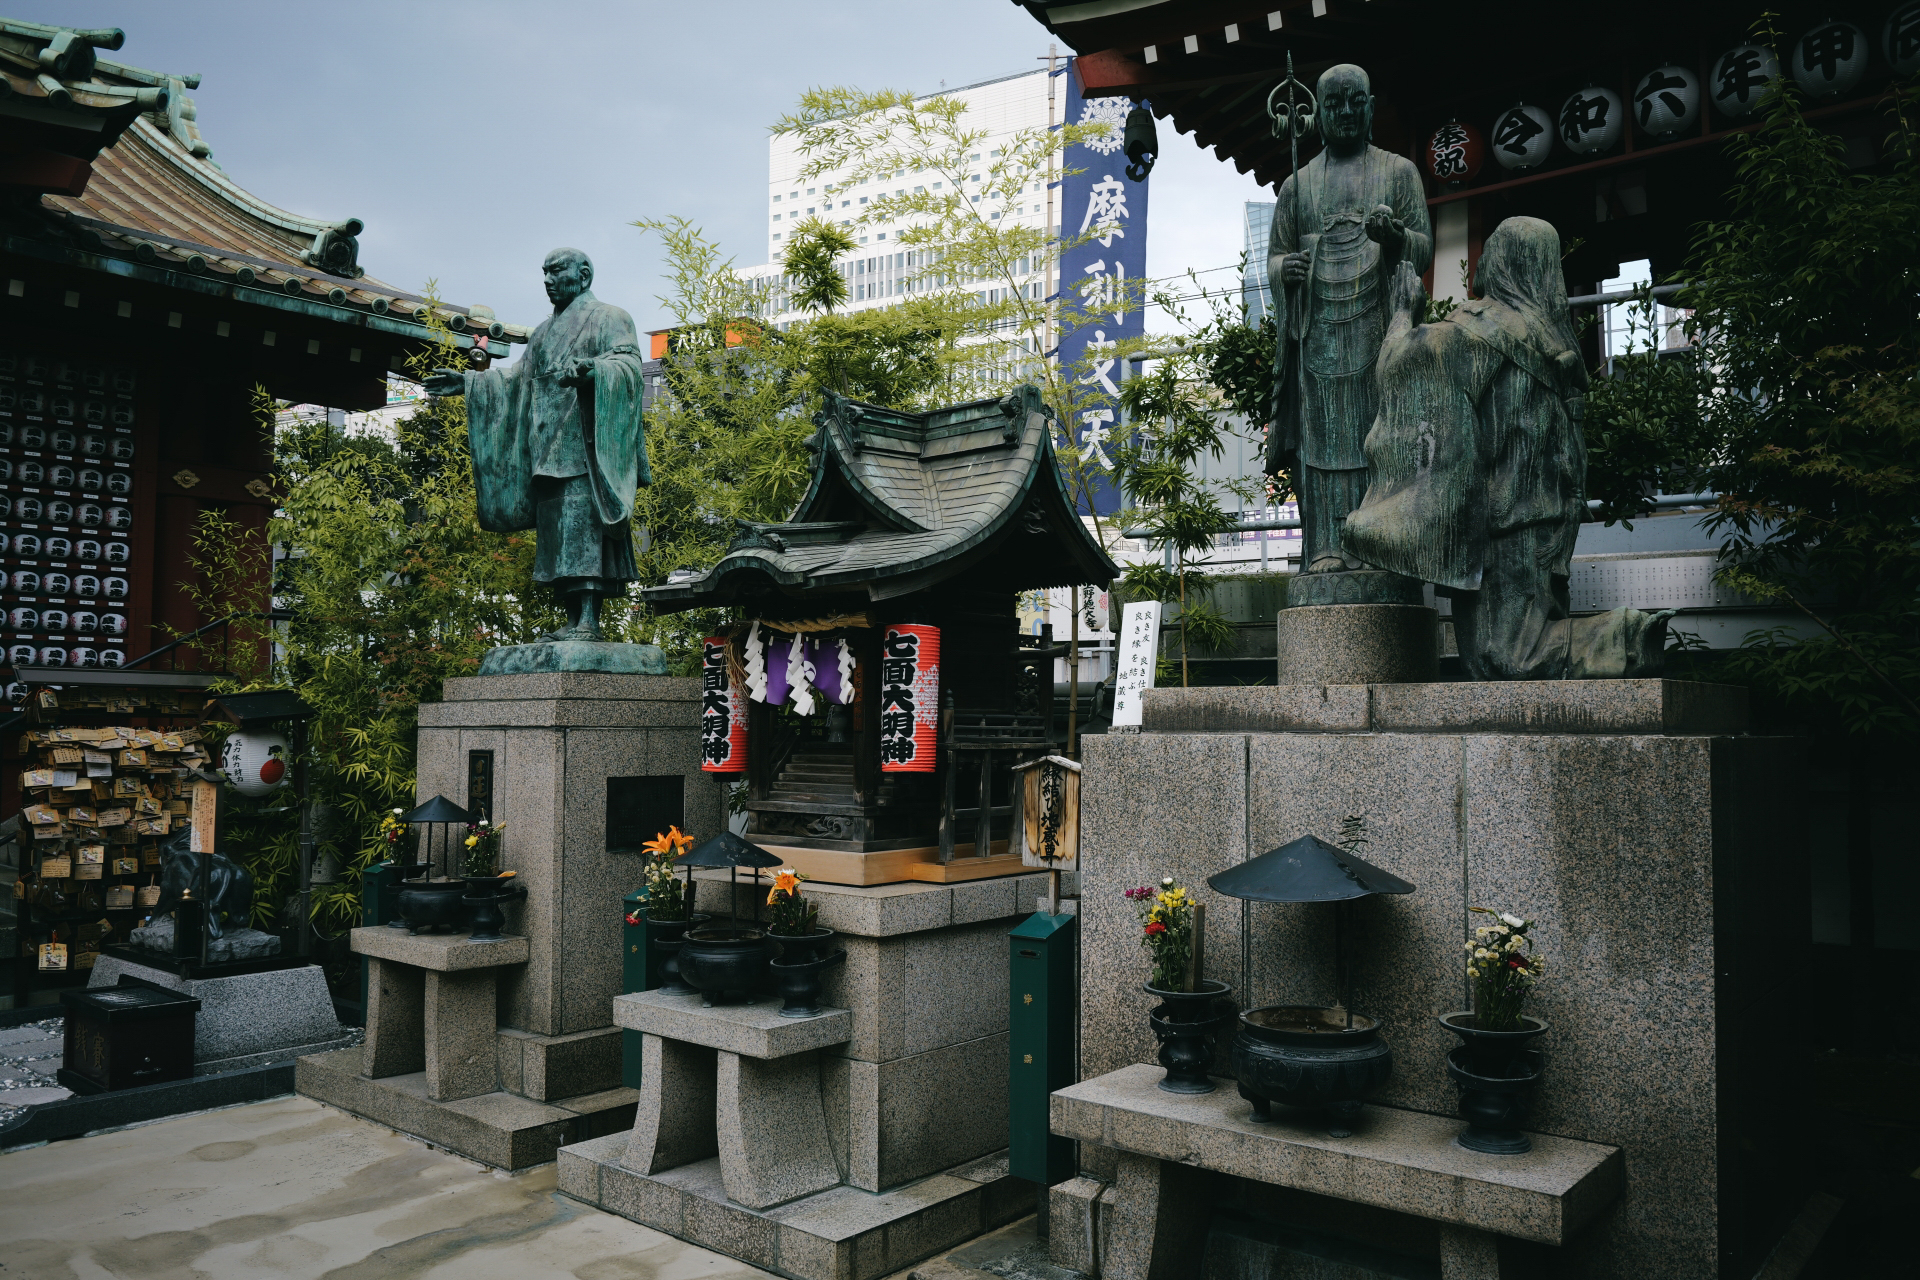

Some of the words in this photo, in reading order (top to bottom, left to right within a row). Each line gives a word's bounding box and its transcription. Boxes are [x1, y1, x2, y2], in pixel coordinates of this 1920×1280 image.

[1432, 123, 1468, 178] 奉祝
[1128, 611, 1144, 690] 良き縁を結ぶ
[1141, 610, 1153, 643] 良き友
[701, 642, 731, 765] 七面大明神
[881, 630, 920, 765] 七面大明神
[1116, 670, 1128, 712] 地蔵尊
[1039, 763, 1064, 867] 縁結び地蔵尊
